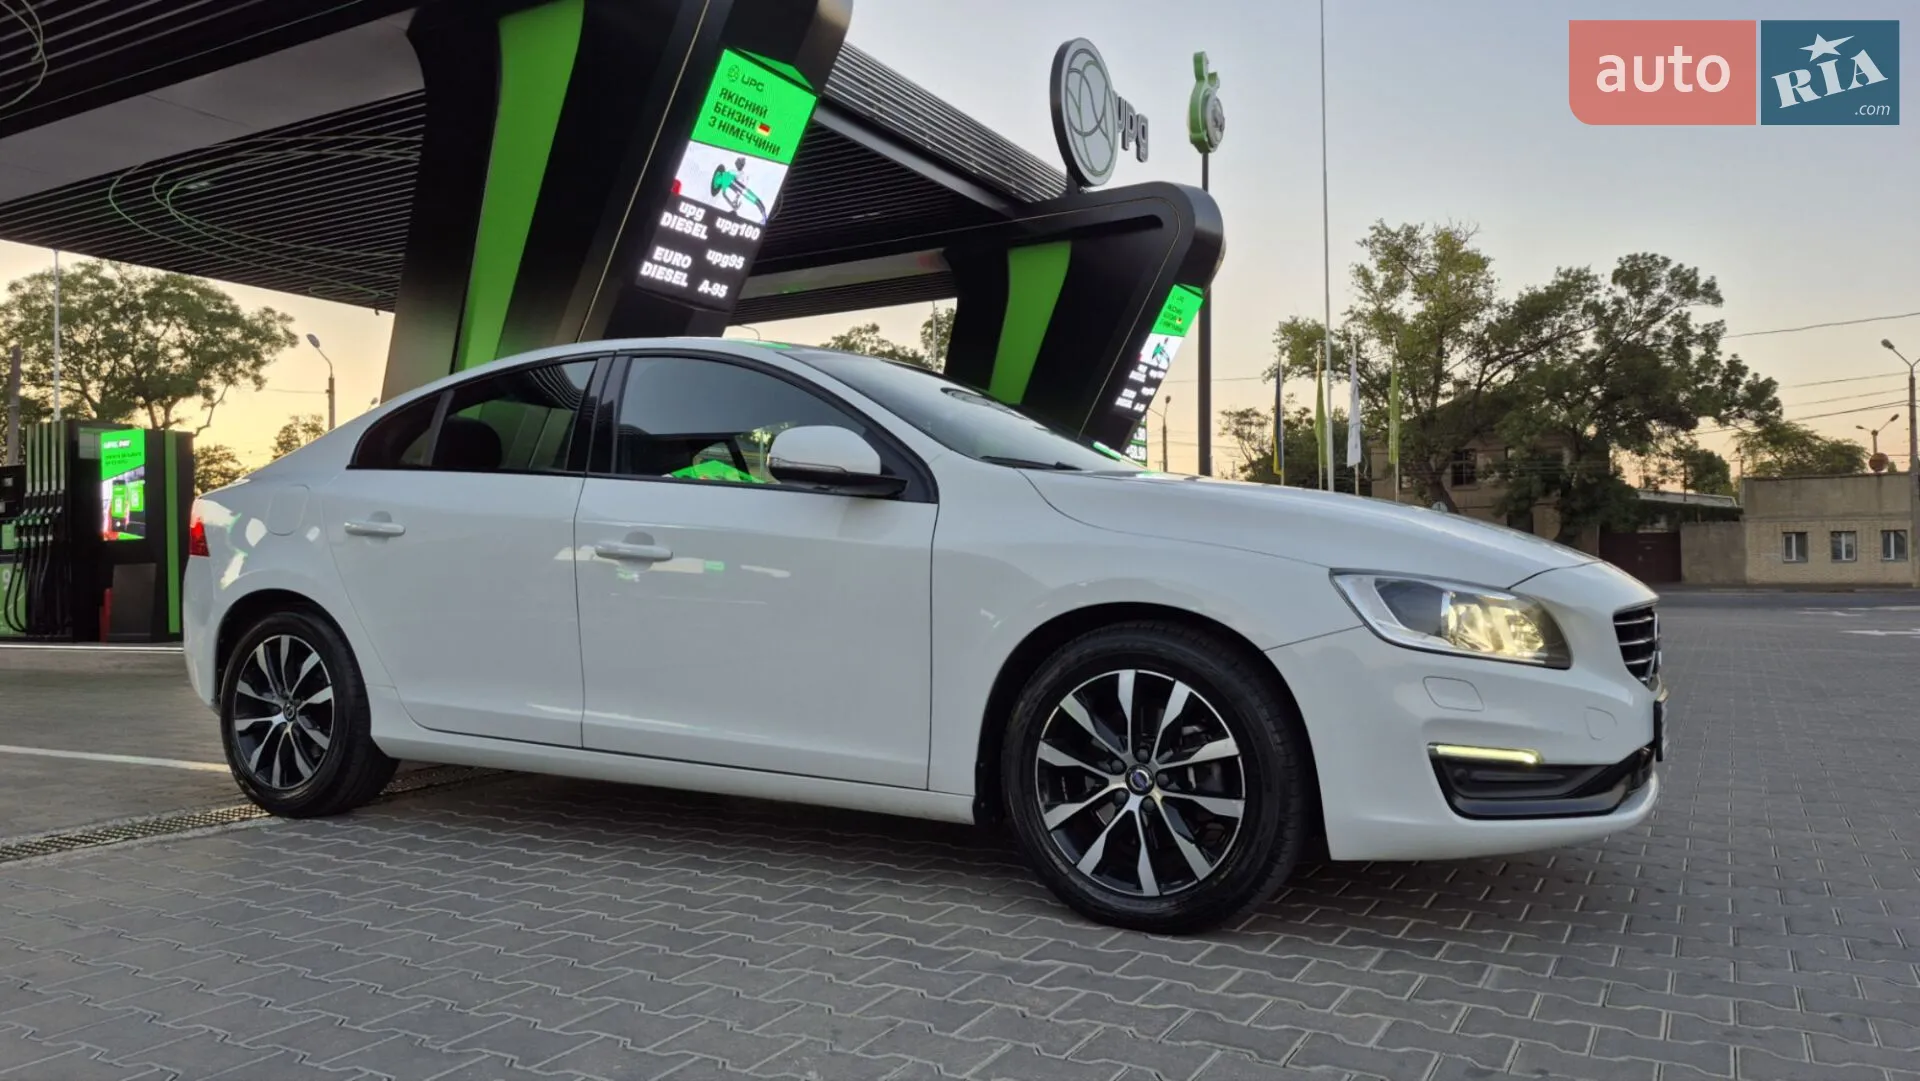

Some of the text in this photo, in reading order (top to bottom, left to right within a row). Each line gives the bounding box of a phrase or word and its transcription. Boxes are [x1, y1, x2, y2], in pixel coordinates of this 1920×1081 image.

[713, 102, 757, 129] БЕНЗИН
[719, 88, 768, 118] ЯКІСНИЙ
[717, 120, 781, 156] НІМЕЧЧИНИ
[679, 201, 706, 222] upg
[660, 211, 708, 240] DIESEL
[715, 217, 761, 241] upg100
[652, 246, 692, 269] EURO
[706, 249, 745, 270] upg95
[640, 261, 688, 287] DIESEL
